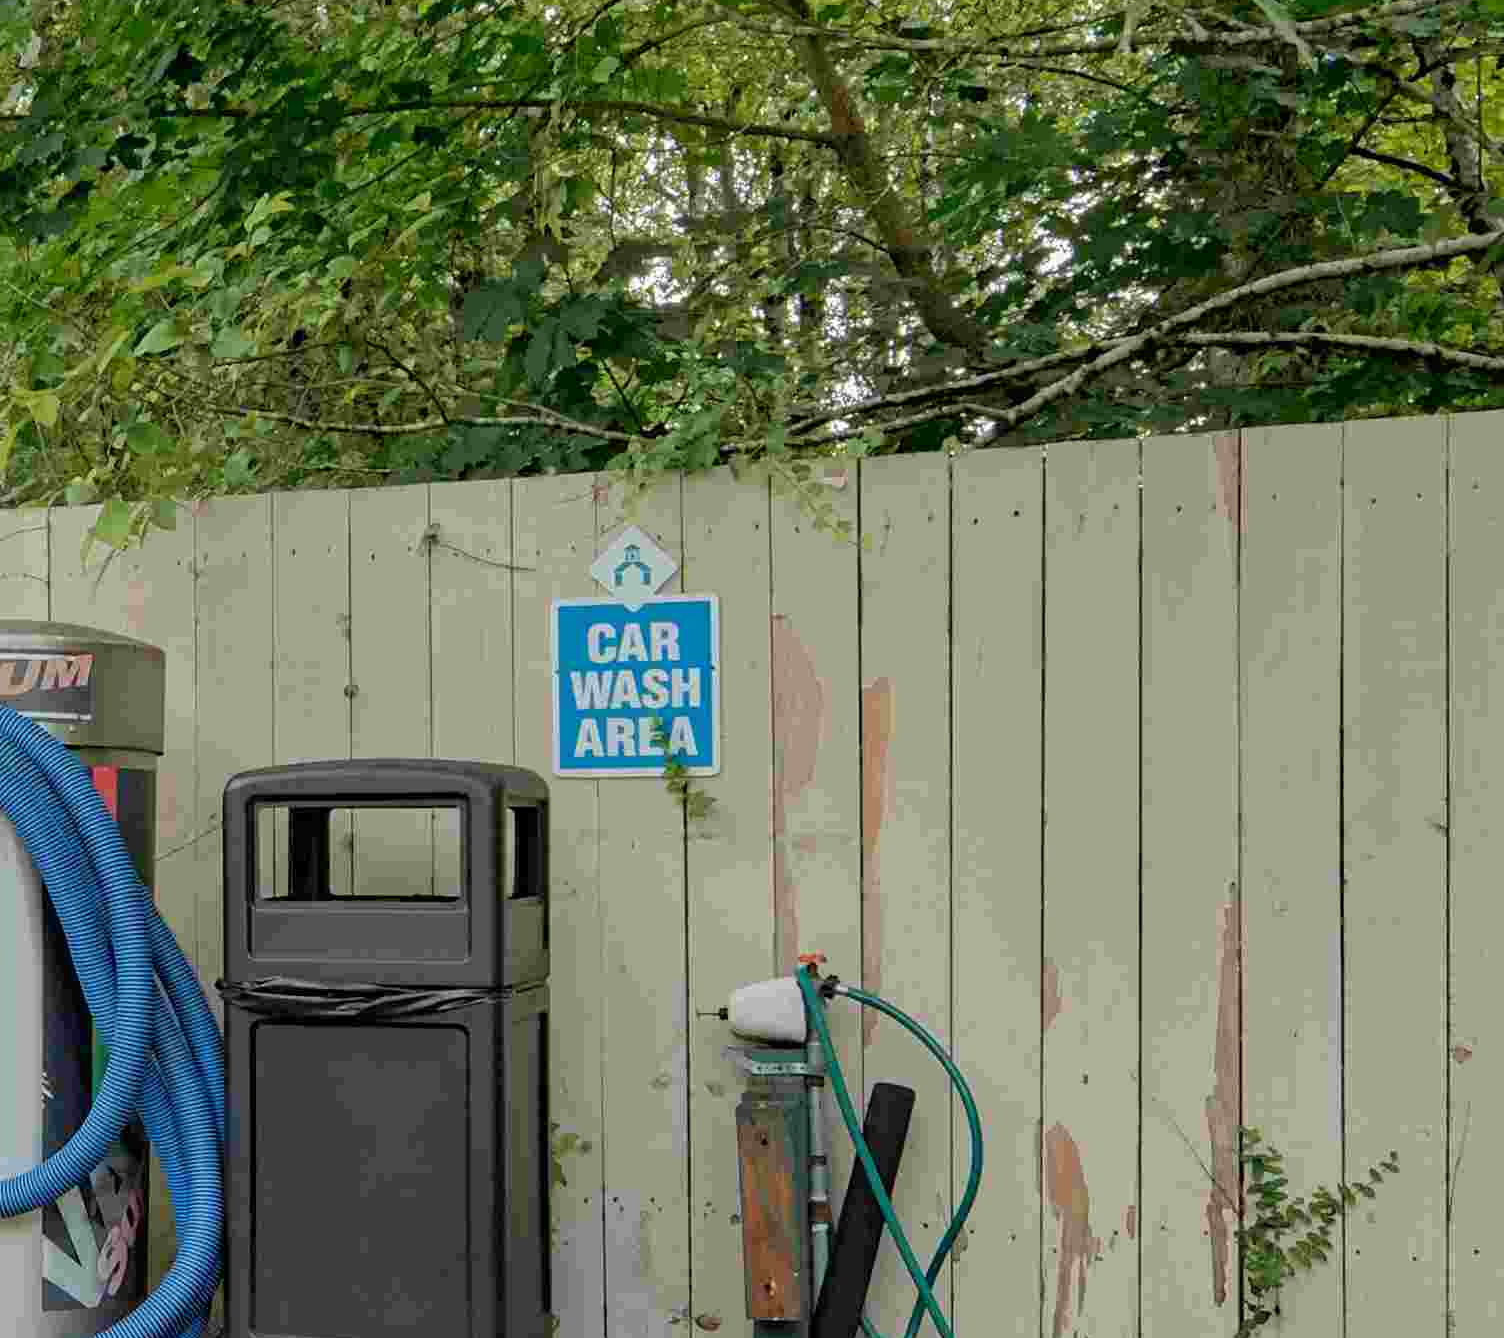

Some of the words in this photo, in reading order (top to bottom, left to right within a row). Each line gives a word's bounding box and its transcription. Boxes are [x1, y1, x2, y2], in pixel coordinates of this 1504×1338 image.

[587, 622, 681, 664] CAR
[570, 667, 701, 709] WASH
[574, 716, 699, 757] AREA
